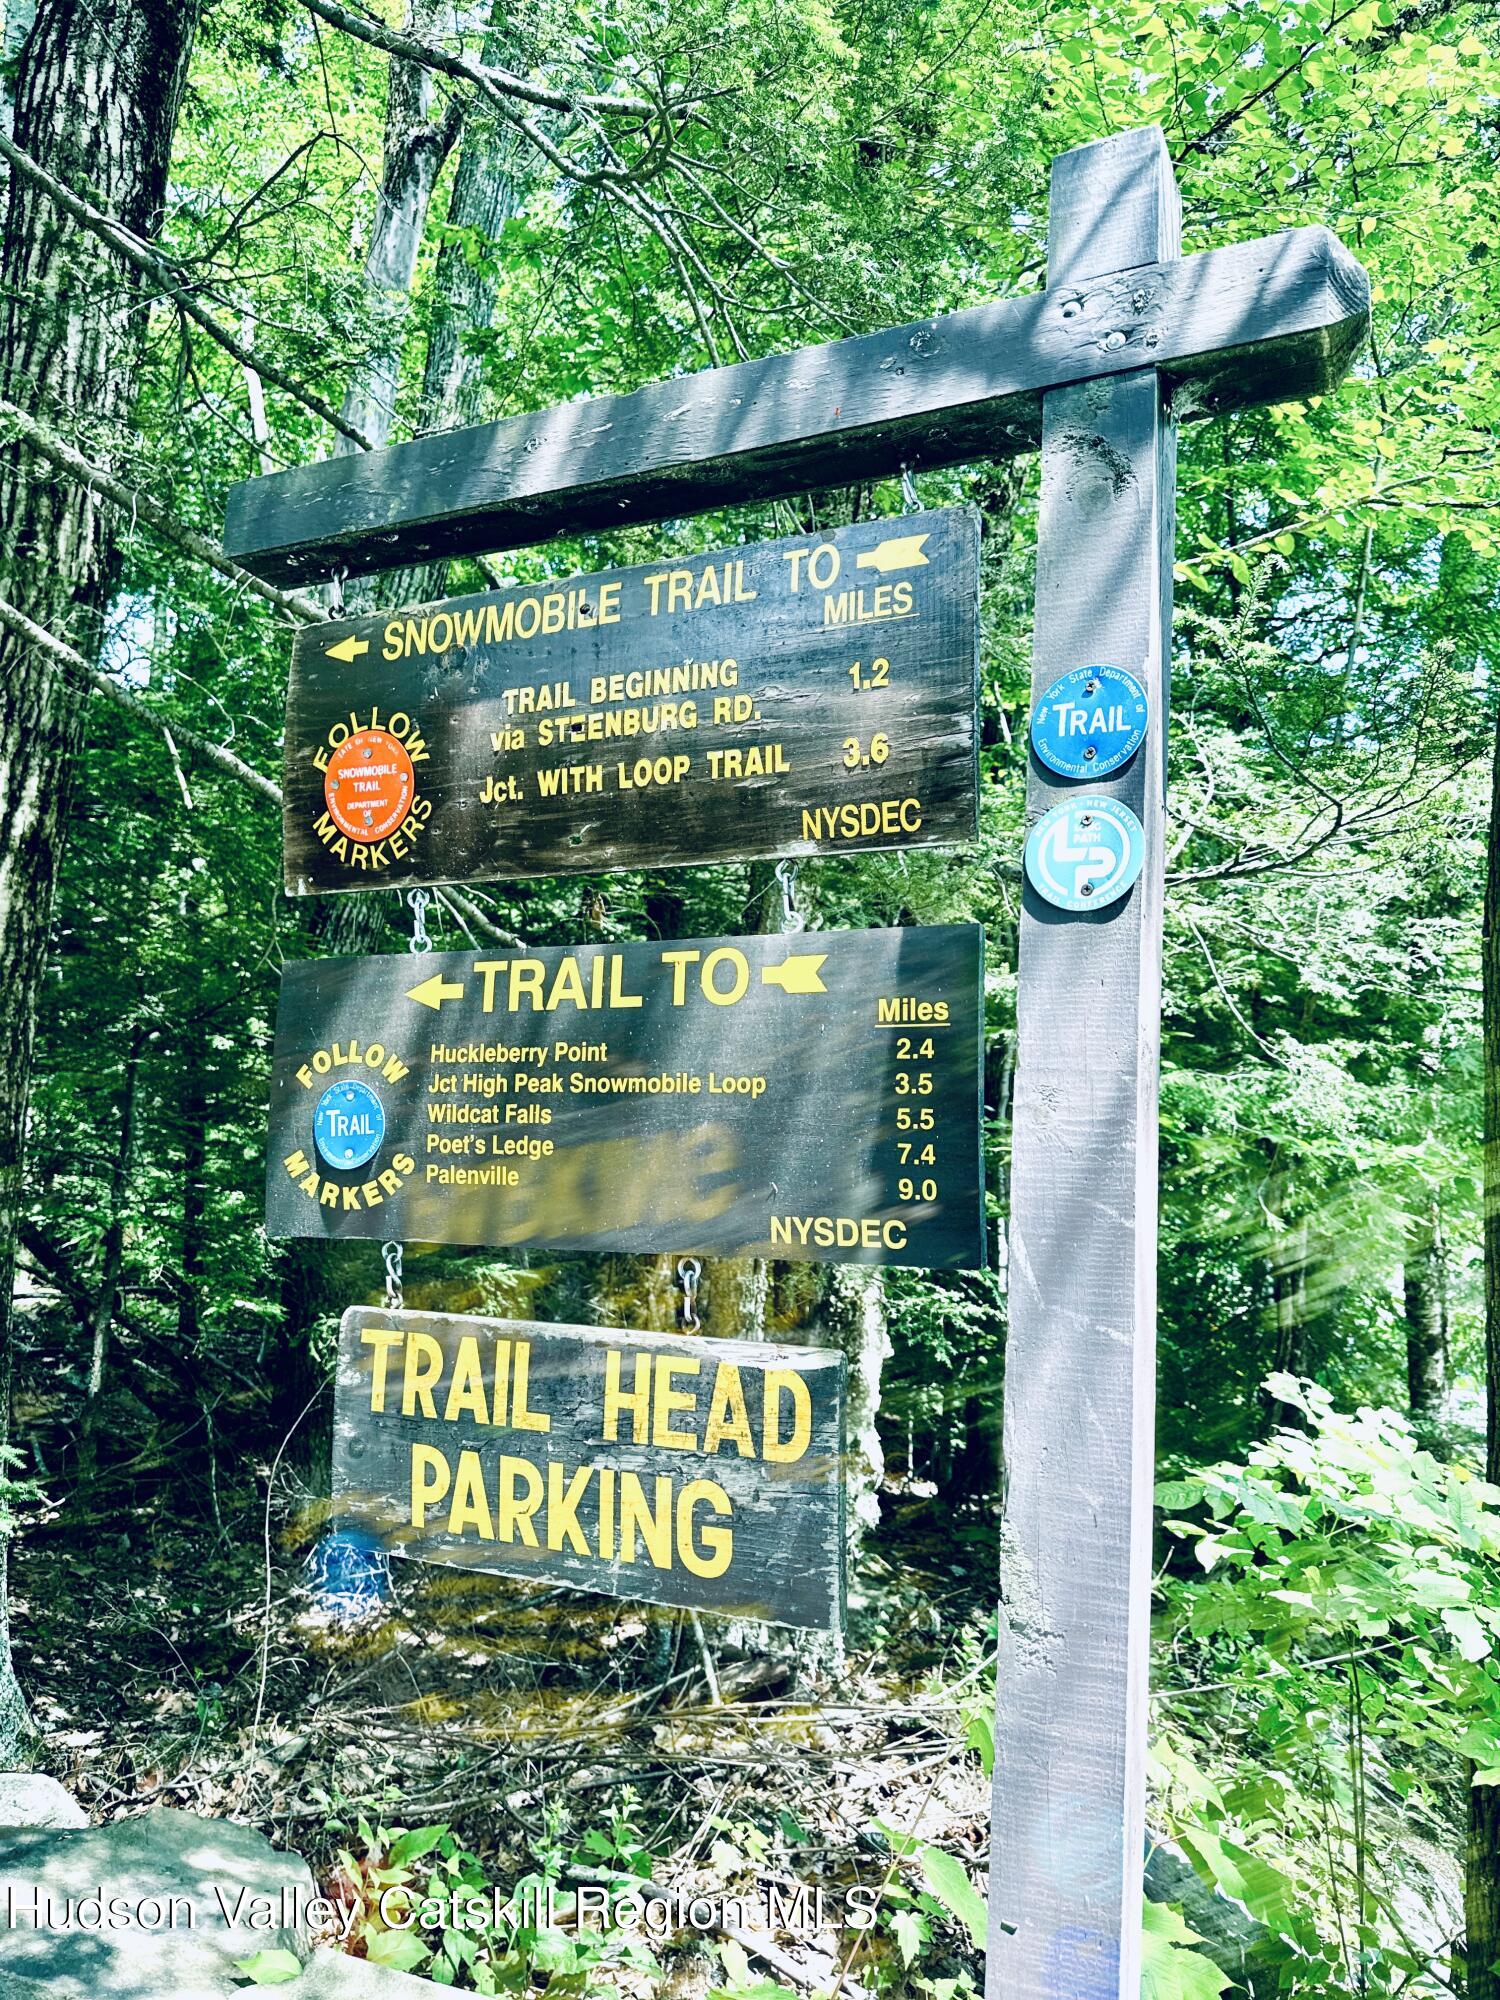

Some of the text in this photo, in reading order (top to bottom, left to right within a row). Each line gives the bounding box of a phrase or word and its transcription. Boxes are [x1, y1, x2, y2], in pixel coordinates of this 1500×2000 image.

[382, 544, 841, 662] SNOWMOBILE TRAIL TO
[824, 582, 914, 624] MILES
[502, 658, 738, 715] TRAIL BEGINNING
[849, 658, 890, 690] 1.2
[1036, 666, 1146, 725] New York State Department of
[490, 694, 761, 752] via STEENBURG RD.
[1052, 701, 1132, 737] TRAIL
[312, 706, 430, 774] FOLLOW
[843, 734, 890, 768] 3.6
[1037, 728, 1142, 774] Environmental Conservation
[338, 763, 398, 779] SNOWMOBILE
[353, 781, 381, 792] TRAIL
[479, 744, 791, 804] Jct. WITH LOOP TRAIL
[347, 799, 388, 810] DEPARTMENT
[802, 798, 923, 841] NYSDEC
[312, 795, 432, 870] MARKERS
[473, 948, 750, 1014] TRAIL TO
[877, 998, 949, 1022] Miles
[295, 1039, 410, 1090] FOLLOW
[430, 1042, 607, 1067] Huckleberry Point
[896, 1038, 935, 1060] 2.4
[428, 1072, 766, 1099] Jct High Peak Snowmobile Loop
[895, 1073, 933, 1095] 3.5
[325, 1109, 375, 1137] TRAIL
[427, 1103, 552, 1125] Wildcat Falls
[896, 1108, 935, 1130] 5.5
[426, 1134, 554, 1160] Poet's Ledge
[897, 1143, 936, 1165] 7.4
[283, 1149, 415, 1211] MARKERS
[426, 1164, 520, 1186] Palenville
[898, 1178, 938, 1201] 9.0
[770, 1215, 908, 1250] NYSDEC
[360, 1328, 812, 1464] TRAIL HEAD
[410, 1442, 734, 1580] PARKING
